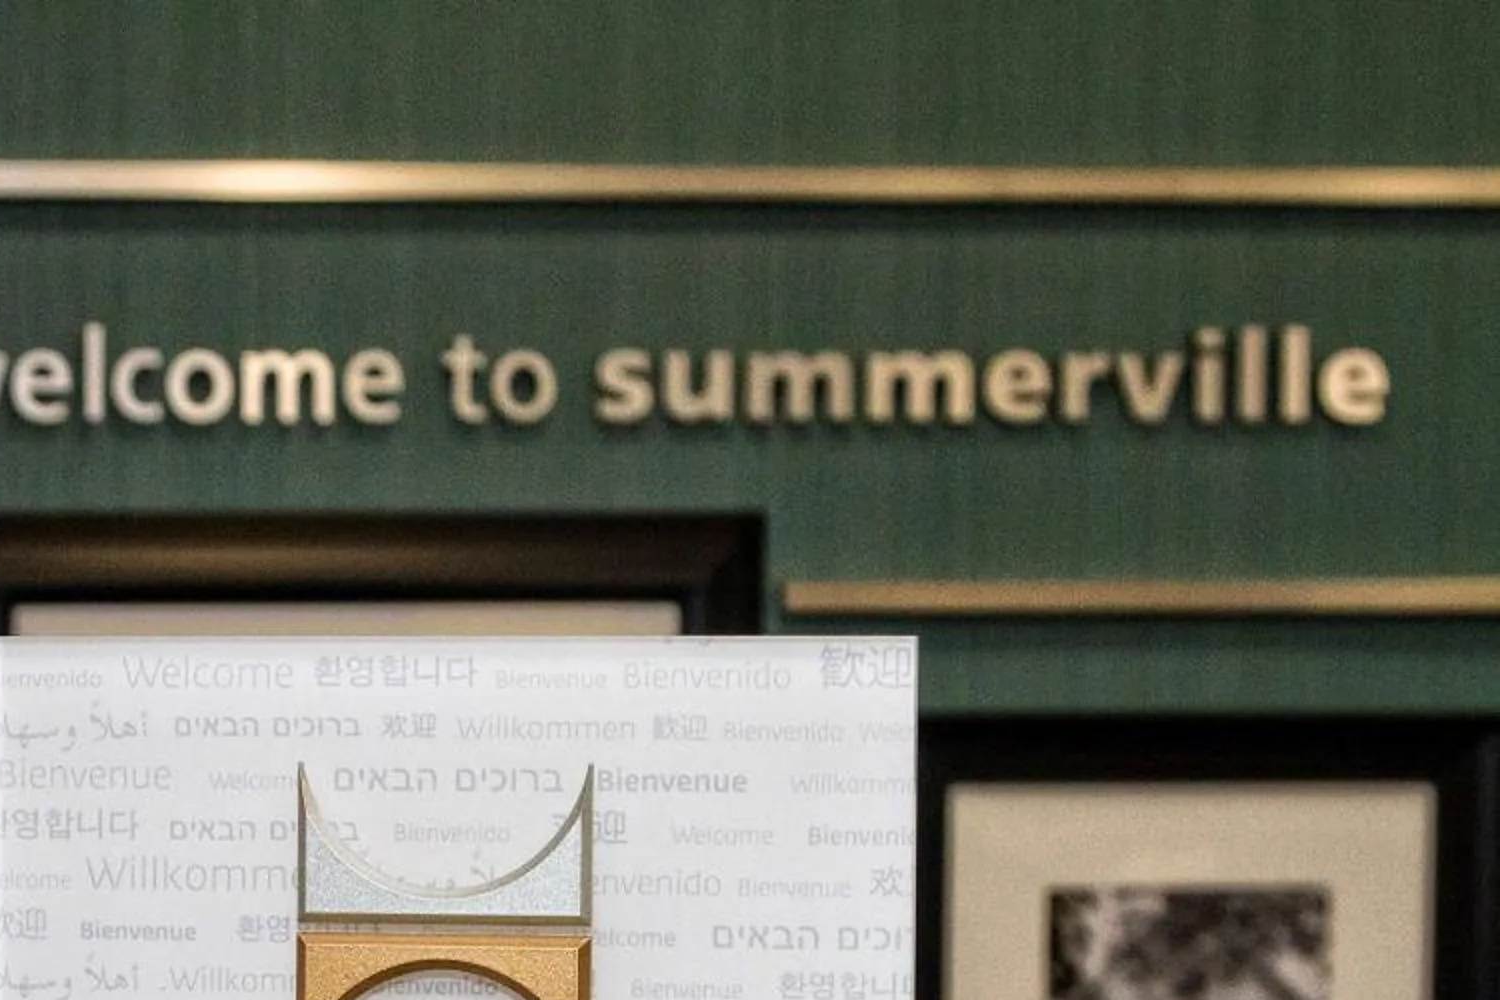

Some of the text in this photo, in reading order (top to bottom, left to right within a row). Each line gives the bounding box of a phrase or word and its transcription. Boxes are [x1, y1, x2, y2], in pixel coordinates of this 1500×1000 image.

[441, 334, 559, 427] to
[595, 325, 1390, 428] summerville
[122, 655, 294, 689] Welcome
[314, 654, 479, 688] 환영합니다
[495, 662, 791, 690] Bienvenue Bienvenido
[819, 643, 912, 691] 歡迎
[175, 715, 361, 738] ברוכים הבאים
[380, 714, 437, 738] 欢迎
[457, 715, 636, 742] Willkommen
[723, 722, 843, 743] Bienvenido
[209, 770, 297, 790] Welcom
[333, 767, 564, 793] ברוכים הבאים
[598, 767, 749, 793] Bienvenue
[169, 817, 257, 841] הבאים
[392, 818, 511, 844] Bienvenido
[671, 824, 774, 845] Welcome
[737, 877, 853, 898] Bienvenue
[80, 921, 197, 941] Bienvenue
[593, 928, 676, 948] elcome
[712, 924, 820, 950] הבאים
[631, 978, 744, 1000] Bienvenue
